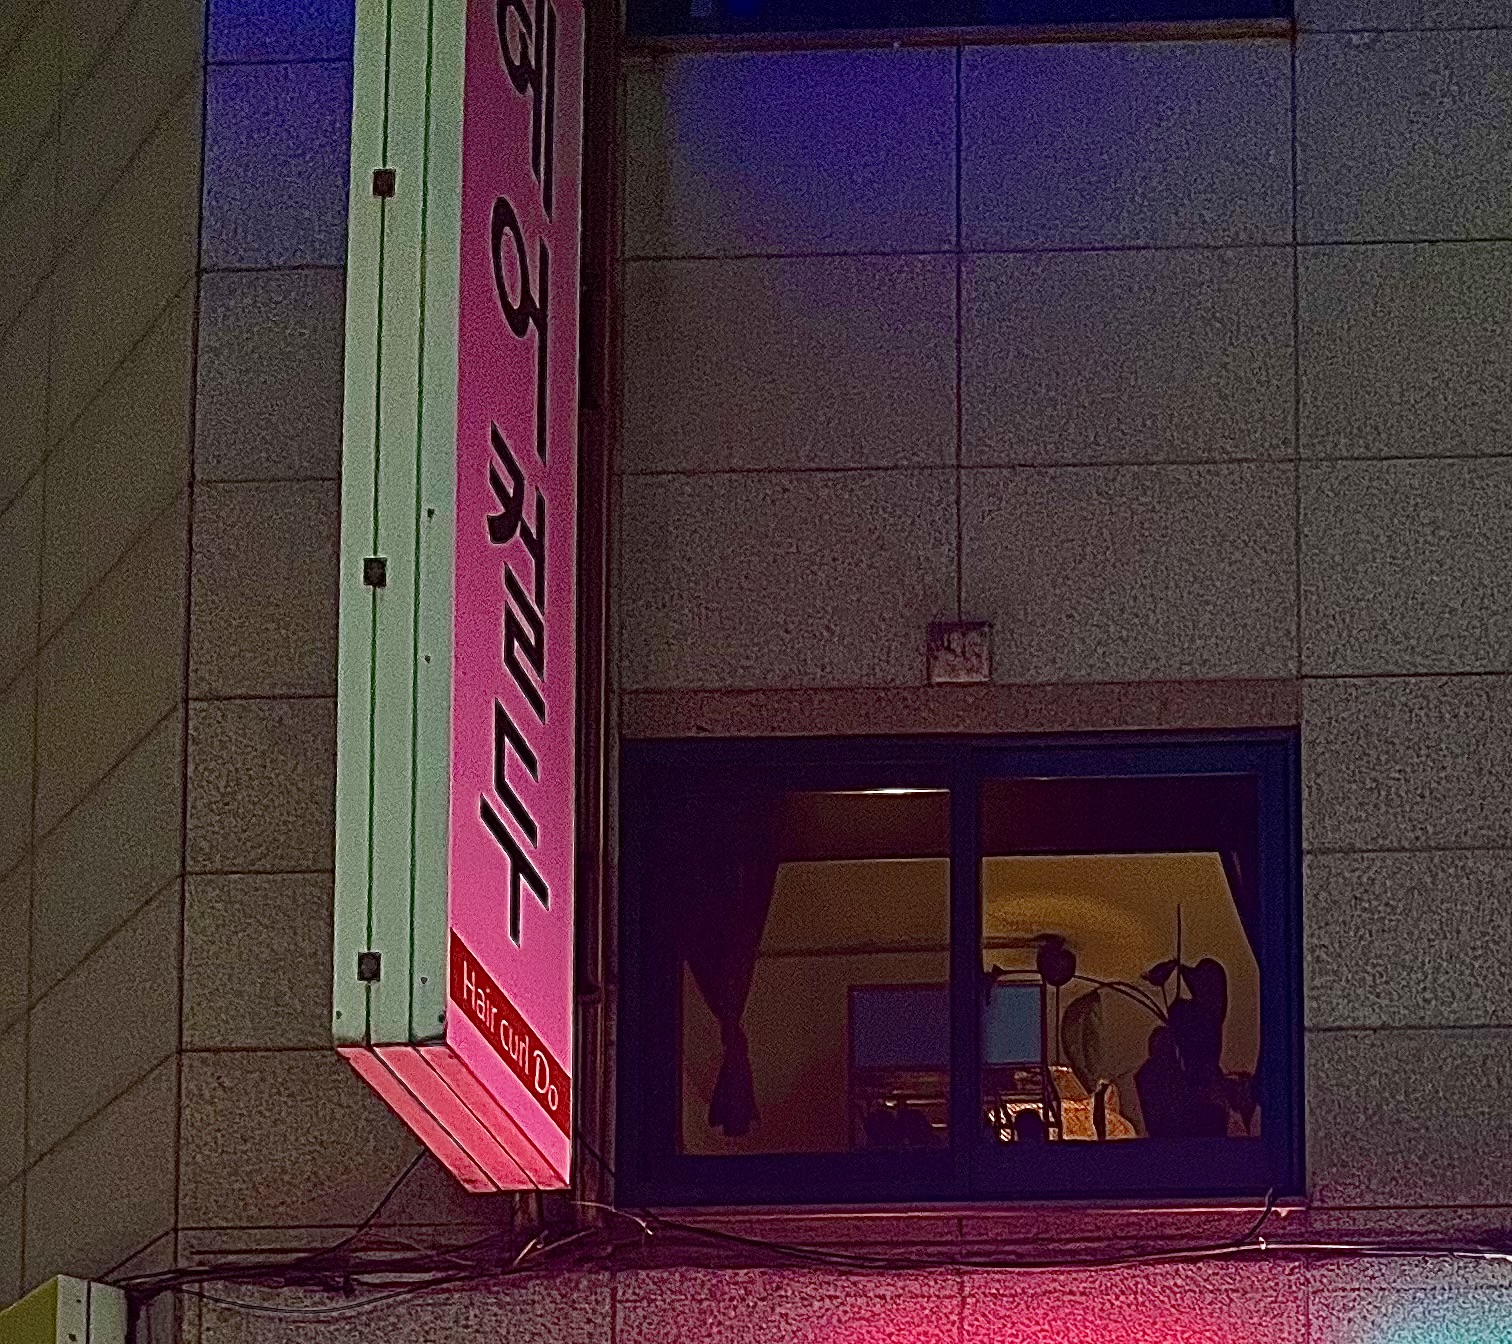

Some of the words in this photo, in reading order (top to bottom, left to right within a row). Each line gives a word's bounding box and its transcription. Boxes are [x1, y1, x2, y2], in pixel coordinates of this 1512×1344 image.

[462, 970, 497, 1033] Hair
[499, 1018, 531, 1075] curl
[533, 1050, 559, 1111] Do
